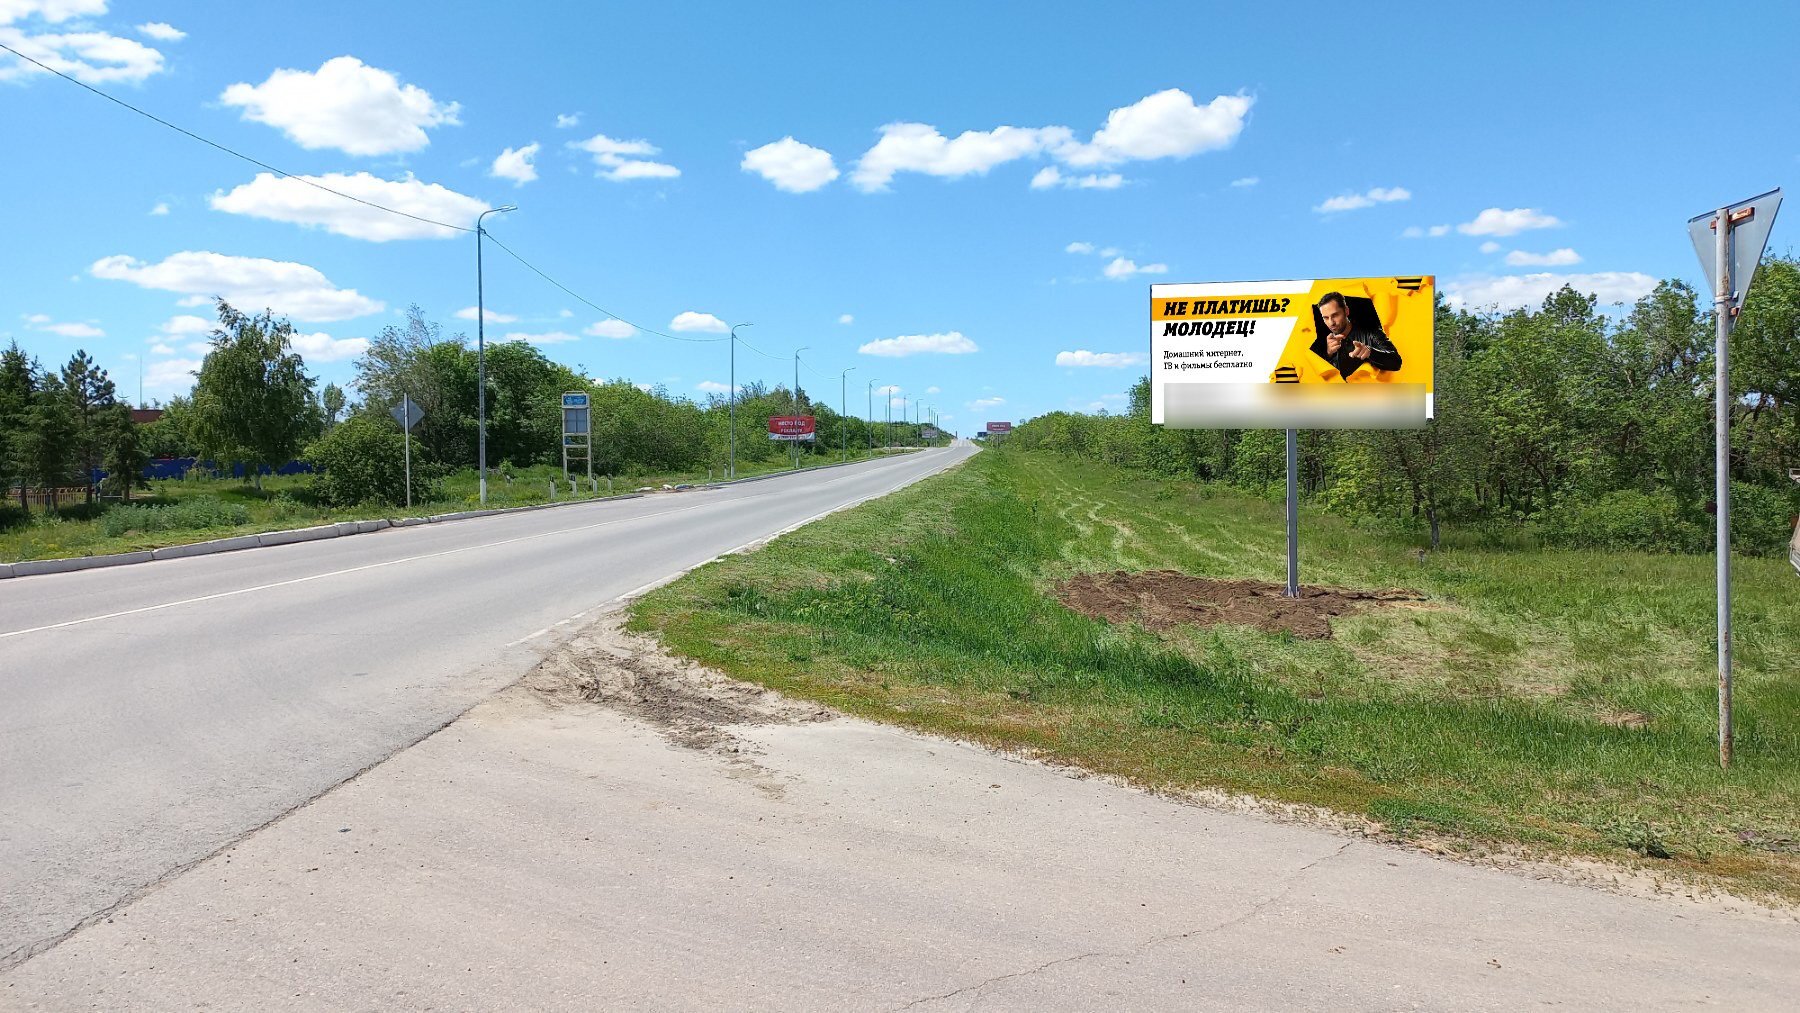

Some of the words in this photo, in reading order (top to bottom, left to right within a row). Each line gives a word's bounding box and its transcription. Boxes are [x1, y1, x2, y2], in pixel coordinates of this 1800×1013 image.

[1163, 301, 1188, 316] НЕ
[1191, 298, 1291, 315] ПЛАТИШЬ?
[1163, 320, 1256, 338] МОЛОДЕЦ!
[1163, 350, 1204, 360] Домашний
[1206, 350, 1244, 359] интернет,
[1163, 362, 1173, 370] ТВ
[1180, 361, 1213, 371] фильмы
[1213, 360, 1253, 369] бесплатно
